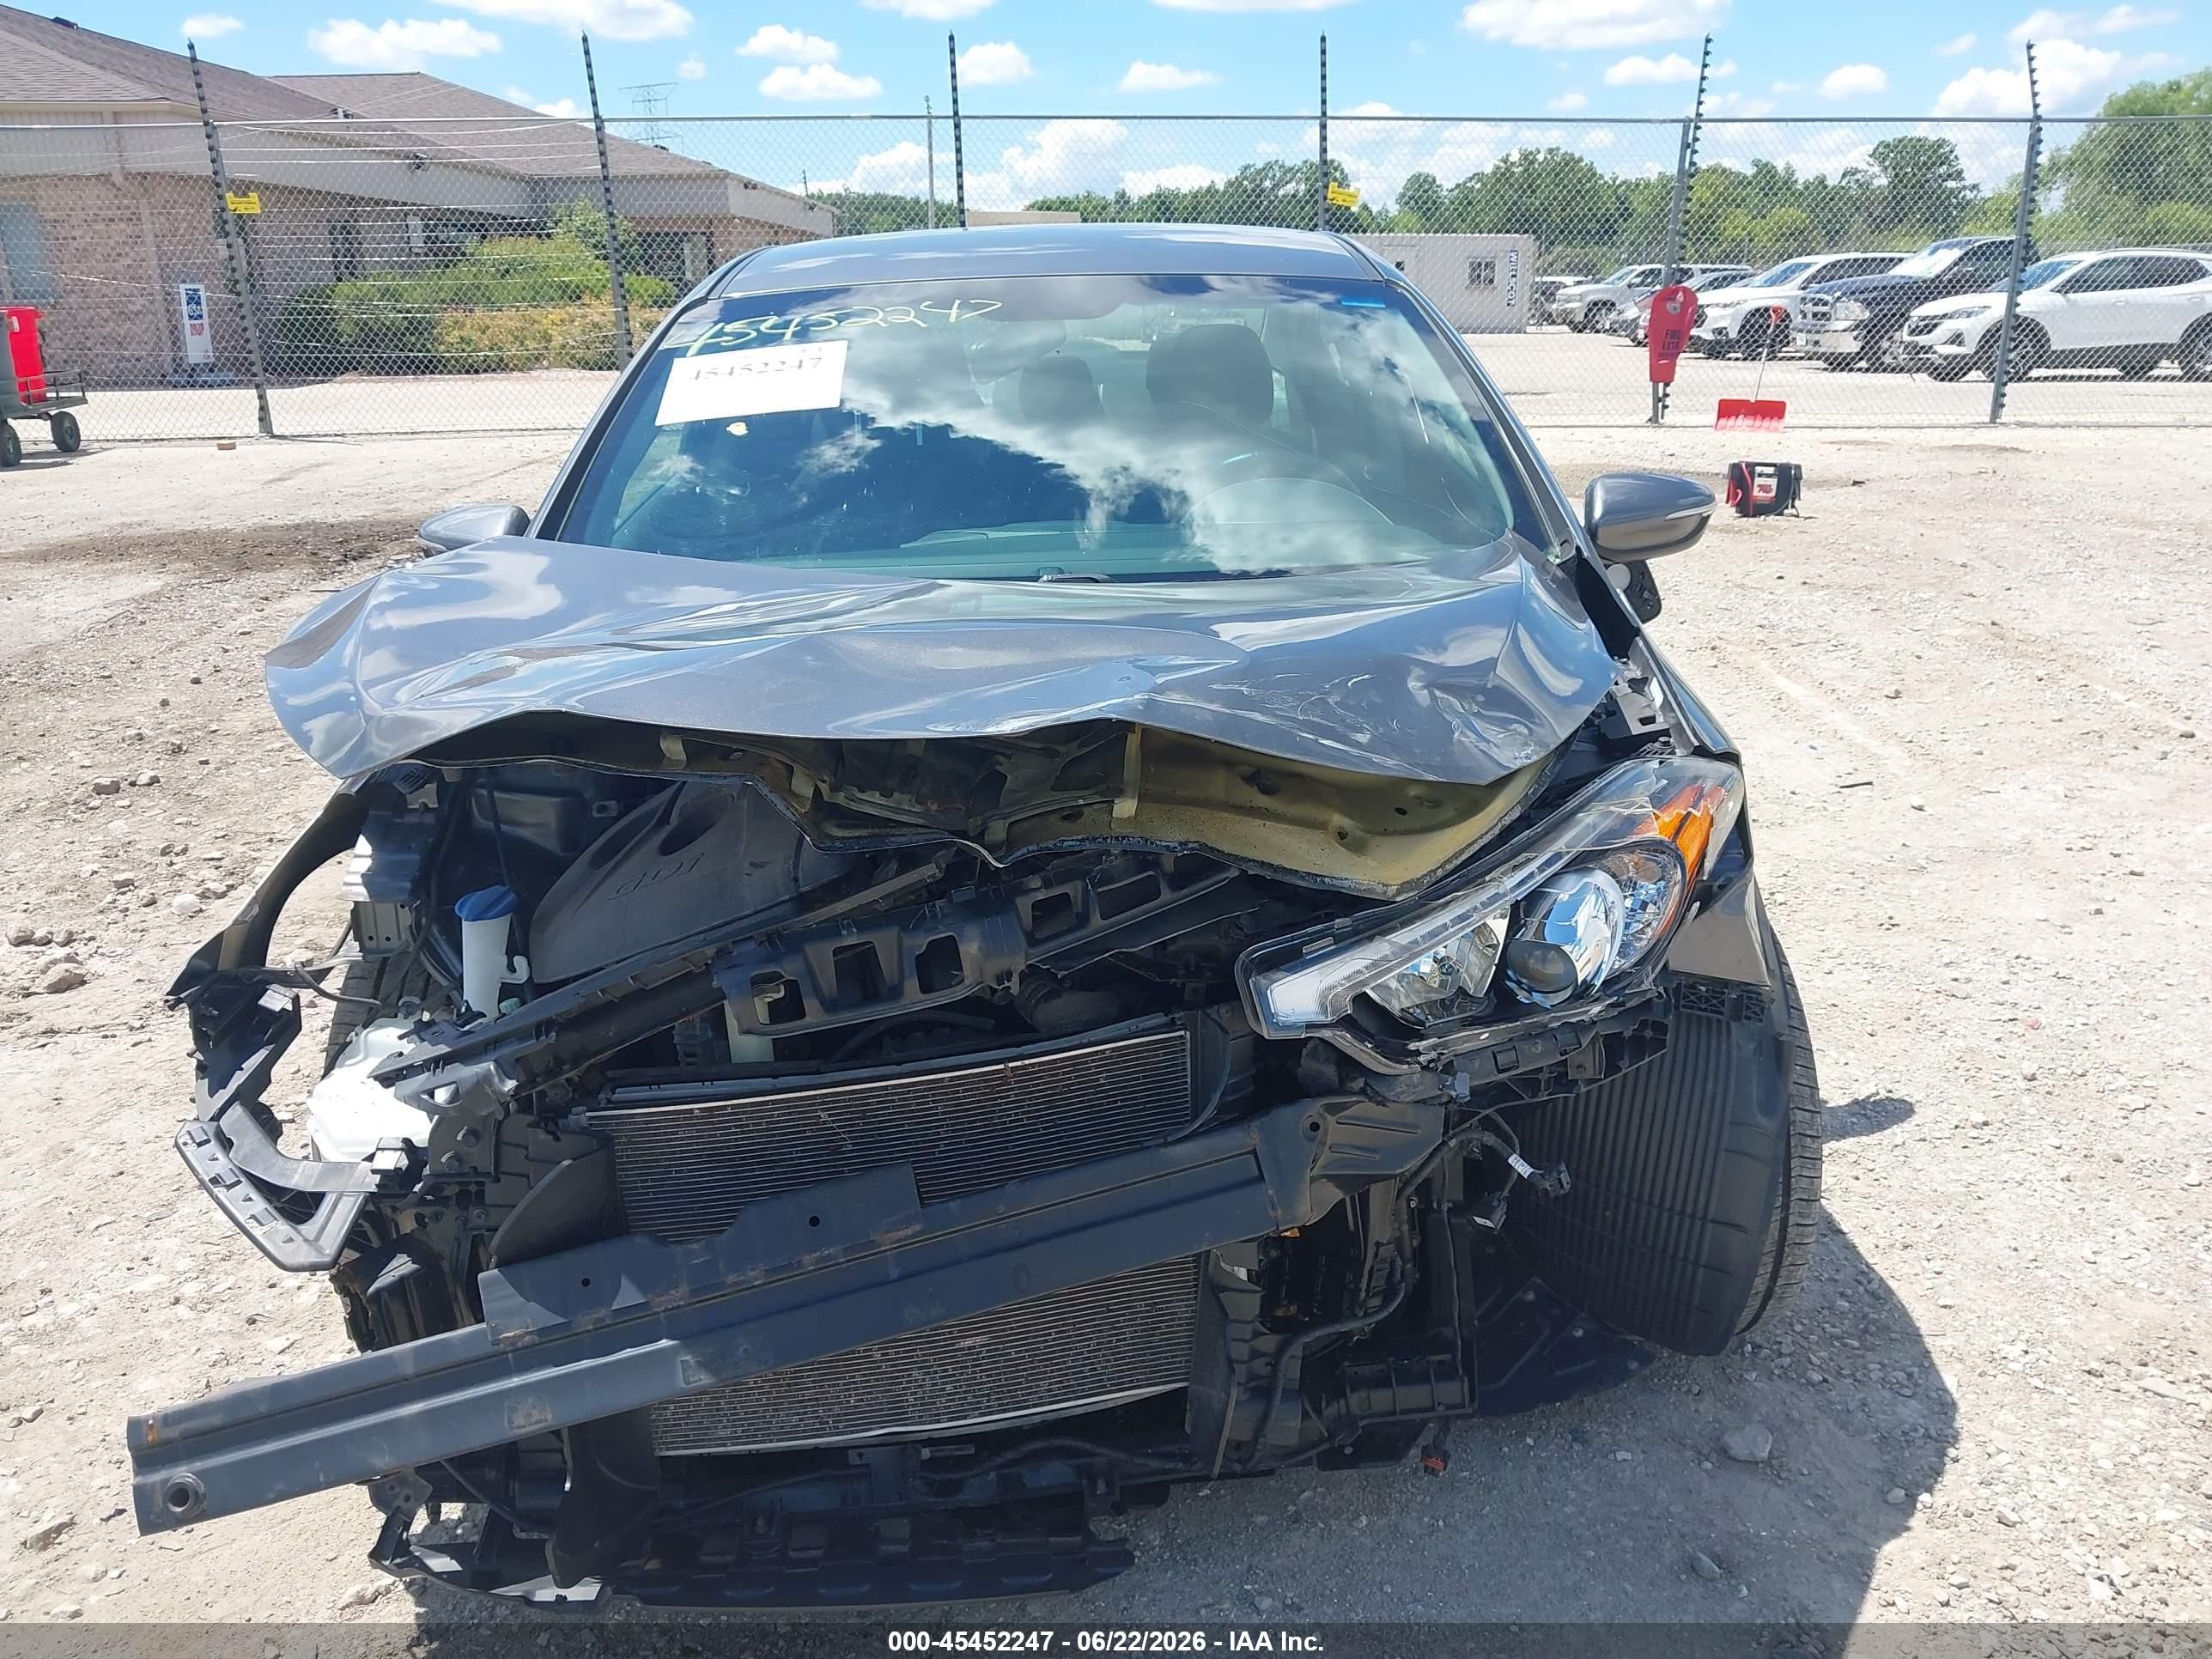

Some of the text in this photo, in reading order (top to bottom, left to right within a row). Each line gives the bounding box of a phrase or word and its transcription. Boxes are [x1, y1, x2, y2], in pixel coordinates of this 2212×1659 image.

[1506, 248, 1519, 307] WILLSCOT
[663, 298, 1003, 357] 45452247
[1665, 329, 1681, 340] FIRE
